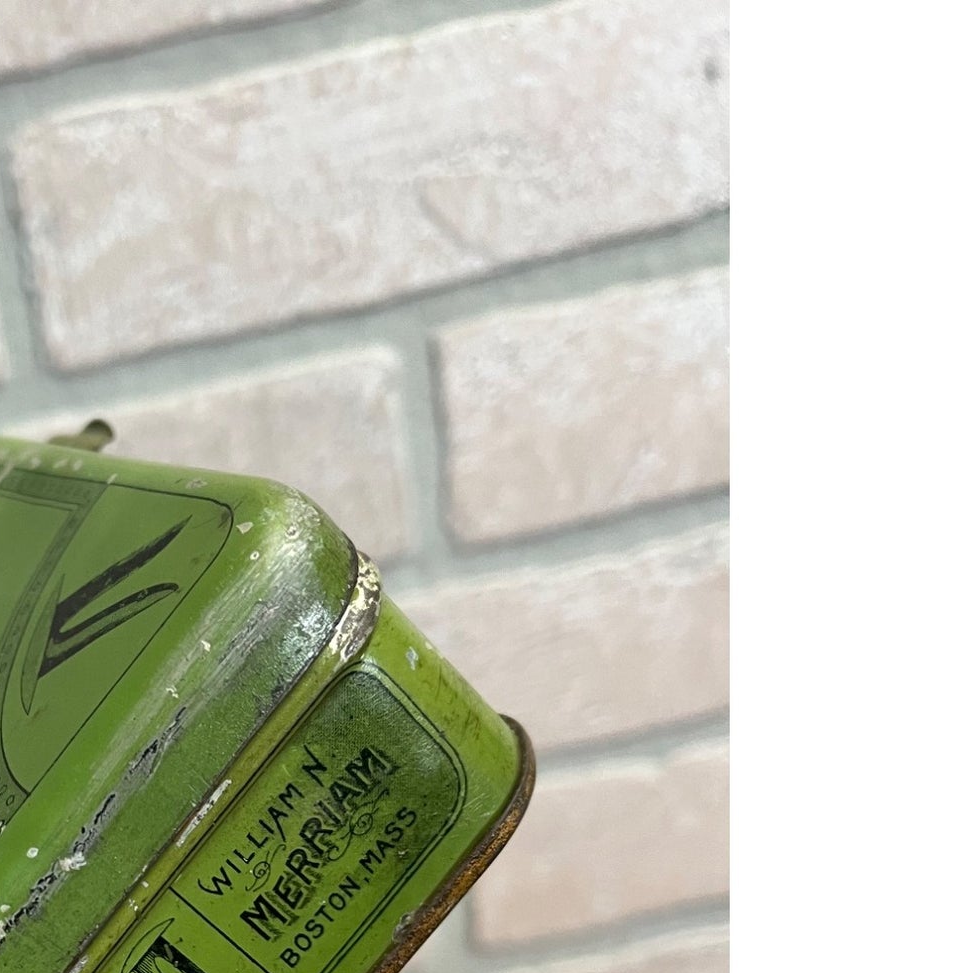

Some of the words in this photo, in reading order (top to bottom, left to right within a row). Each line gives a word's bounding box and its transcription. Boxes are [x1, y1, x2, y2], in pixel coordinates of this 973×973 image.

[197, 782, 305, 897] WILLIAM
[239, 746, 397, 942] MERRIAM
[358, 805, 418, 875] MASS
